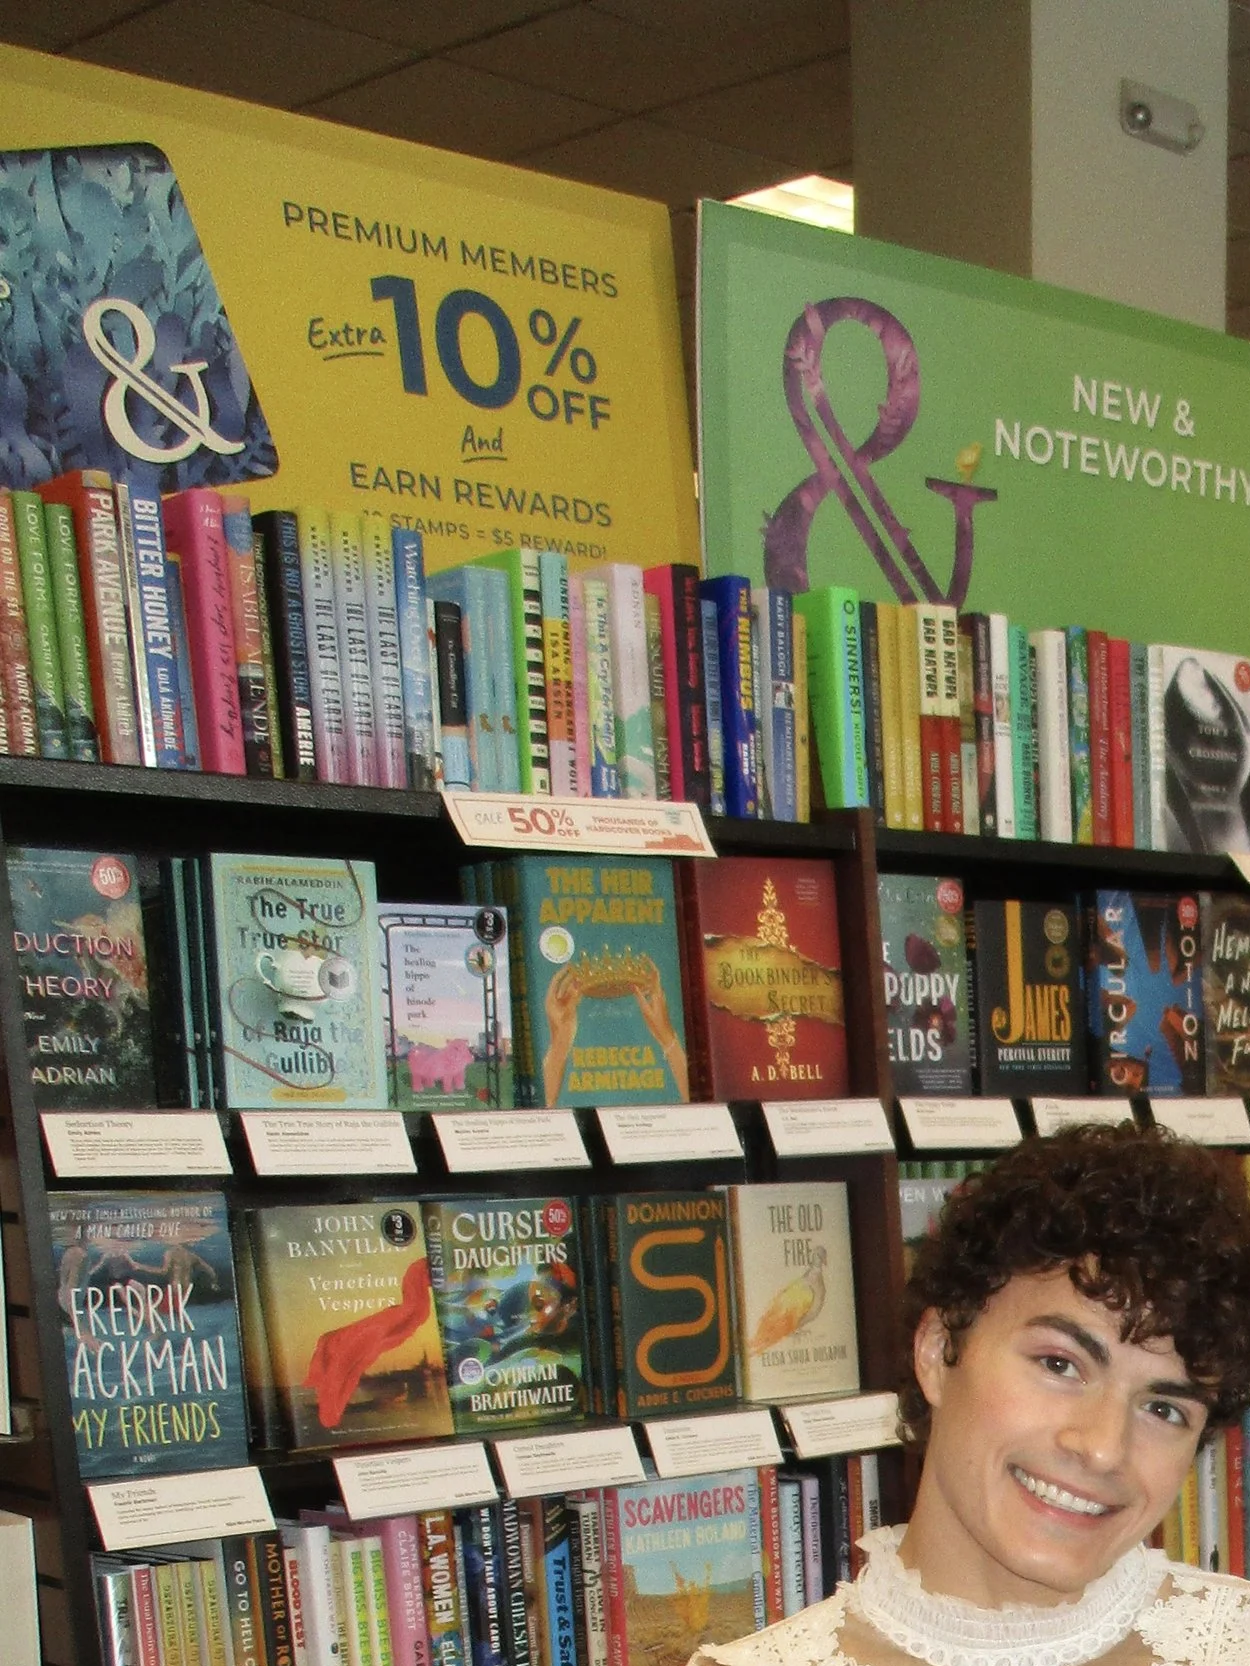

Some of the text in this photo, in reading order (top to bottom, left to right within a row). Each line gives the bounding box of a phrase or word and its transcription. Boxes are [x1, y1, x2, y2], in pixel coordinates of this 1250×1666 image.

[283, 201, 619, 299] PREMIUM MEMBERS
[526, 384, 611, 430] OFF
[1073, 374, 1196, 438] NEW &
[350, 462, 614, 528] EARN REWARDS
[492, 528, 514, 547] $5
[133, 498, 173, 660] BITTER HONEY
[96, 559, 127, 647] AVENUE
[737, 616, 753, 711] NIMBUS
[775, 629, 787, 678] BALOGH
[844, 625, 862, 715] SINNERS!
[295, 706, 314, 766] AMERIE
[474, 811, 504, 826] SALE
[557, 827, 581, 839] OFF
[586, 824, 637, 836] HARDCOVER
[591, 815, 646, 826] THOUSANDS
[602, 869, 654, 895] HEIR
[248, 895, 346, 922] The True
[539, 898, 666, 925] APPARENT
[13, 930, 134, 957] DUCTION
[404, 956, 437, 970] healing
[404, 970, 431, 982] hippo
[991, 899, 1072, 1046] JAMES
[765, 990, 829, 1013] SECRET
[883, 971, 961, 1007] POPPY
[1103, 905, 1128, 1088] CIRCULAR
[38, 1035, 101, 1053] EMILY
[571, 1046, 656, 1068] REBECCA
[887, 1028, 943, 1062] ELDS
[31, 1066, 117, 1085] ADRIAN
[567, 1069, 666, 1092] ARMITAGE
[788, 1064, 824, 1081] BELL
[313, 1214, 376, 1234] JOHN
[452, 1209, 547, 1243] CURSE
[626, 1200, 725, 1225] DOMINION
[799, 1203, 824, 1232] OLD
[453, 1241, 568, 1271] DAUGHTERS
[308, 1273, 399, 1292] Venetian
[70, 1282, 197, 1340] FREDRIK
[318, 1295, 396, 1315] Vespers
[73, 1335, 228, 1401] ACKMAN
[485, 1362, 559, 1388] OYINKAN
[470, 1384, 575, 1413] BRAITHWAITE
[72, 1401, 223, 1449] MY FRIENDS
[623, 1486, 746, 1528] SCAVENGERS
[503, 1499, 523, 1588] MADWOMAN
[770, 1508, 780, 1560] BLOSSOM
[480, 1508, 497, 1620] WE ABOUT
[265, 1543, 285, 1621] MOTHER
[430, 1553, 455, 1625] WOMEN
[552, 1556, 567, 1612] Trust
[233, 1560, 254, 1653] GO TO HELL
[510, 1591, 530, 1659] CHELSEA
[556, 1616, 569, 1632] &
